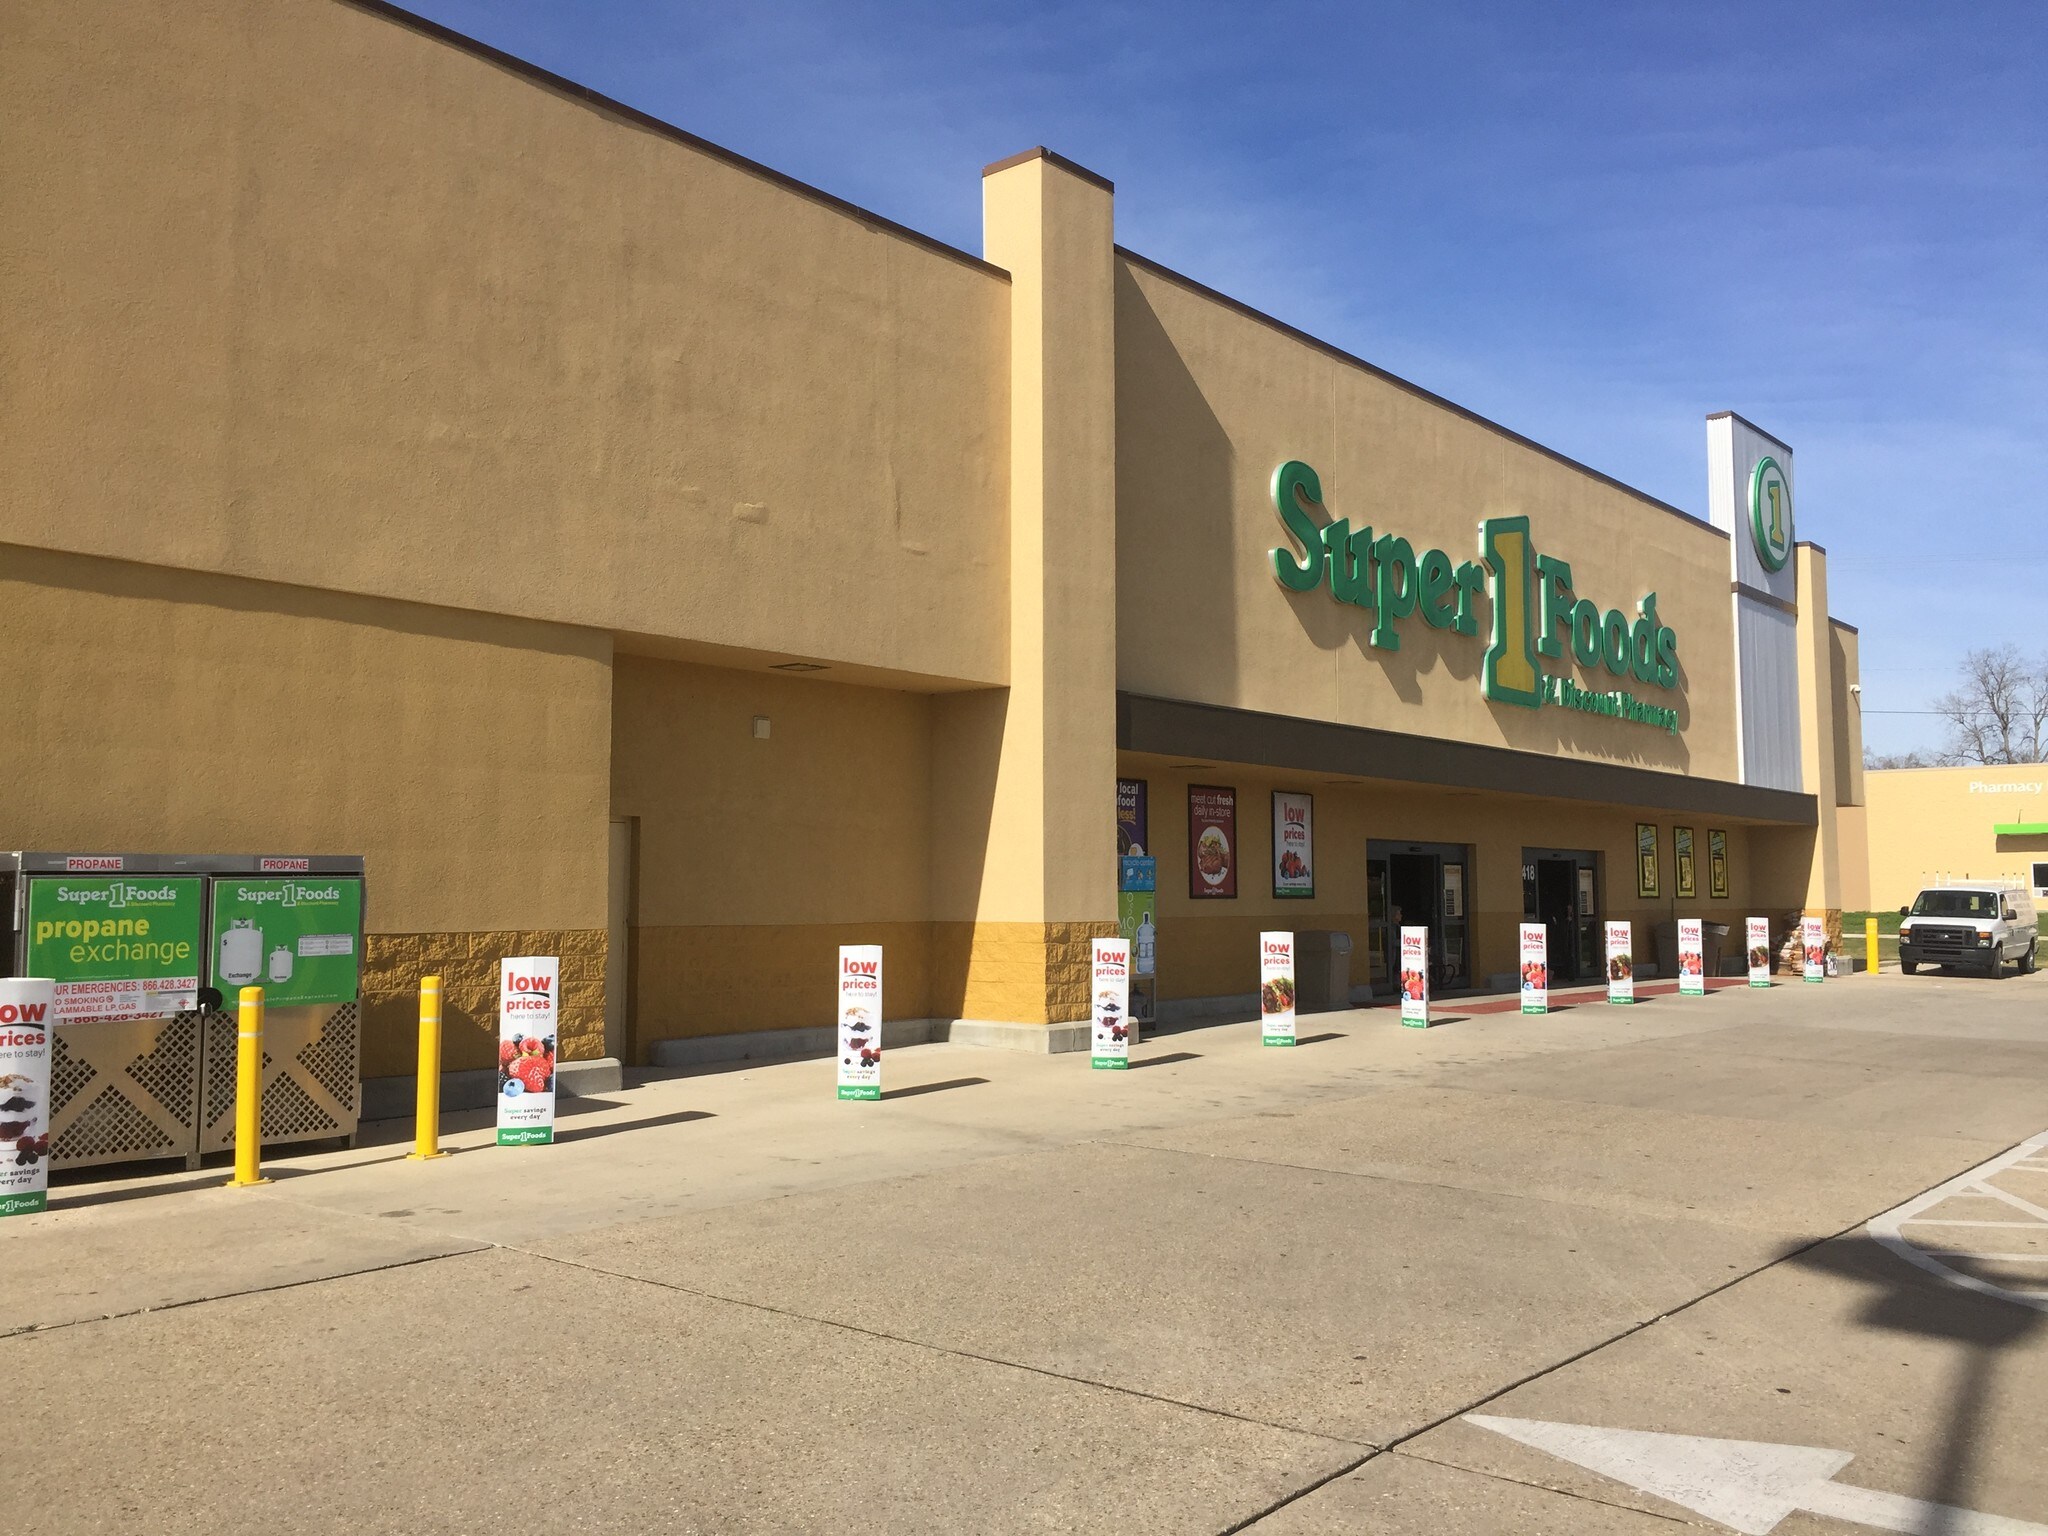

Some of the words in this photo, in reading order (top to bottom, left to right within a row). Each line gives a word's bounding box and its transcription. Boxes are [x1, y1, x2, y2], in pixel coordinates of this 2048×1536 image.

[1768, 480, 1784, 552] 1
[1269, 460, 1484, 651] Super
[1478, 515, 1541, 709] 1
[1536, 553, 1679, 688] Foods
[1555, 678, 1617, 716] Discount
[1616, 691, 1678, 736] Pharmacy
[1120, 782, 1138, 794] local
[1969, 781, 2042, 795] Pharmacy
[1118, 794, 1135, 806] food
[1217, 794, 1233, 806] fresh
[1284, 802, 1304, 822] low
[1284, 827, 1304, 841] prices
[69, 859, 121, 869] PROPANE
[263, 860, 308, 869] PROPANE
[57, 886, 109, 905] Super
[109, 883, 126, 908] 1
[126, 885, 177, 900] Foods
[237, 887, 282, 904] Super
[282, 883, 296, 907] 1
[296, 886, 340, 900] Foods
[36, 918, 150, 945] propane
[1524, 930, 1543, 940] low
[1611, 928, 1628, 936] low
[1681, 925, 1699, 934] low
[1403, 934, 1421, 945] low
[69, 939, 190, 966] exchange
[1264, 941, 1289, 953] low
[1403, 948, 1421, 956] prices
[1097, 949, 1126, 962] low
[1264, 956, 1290, 966] prices
[844, 957, 877, 973] low
[1096, 966, 1126, 977] prices
[54, 984, 69, 996] UR
[71, 981, 140, 995] EMERGENCIES:
[143, 978, 196, 991] 866.428.3427
[508, 972, 551, 991] low
[842, 978, 877, 991] prices
[64, 996, 105, 1005] SMOKING
[506, 997, 551, 1013] prices
[0, 1003, 47, 1023] ow
[54, 1005, 103, 1014] LAMMABLE
[0, 1030, 45, 1046] rices
[14, 1050, 23, 1058] to
[25, 1048, 45, 1058] stay!
[502, 1133, 521, 1141] Super
[10, 1168, 40, 1176] savings
[17, 1176, 32, 1184] day
[14, 1199, 40, 1208] Foods
